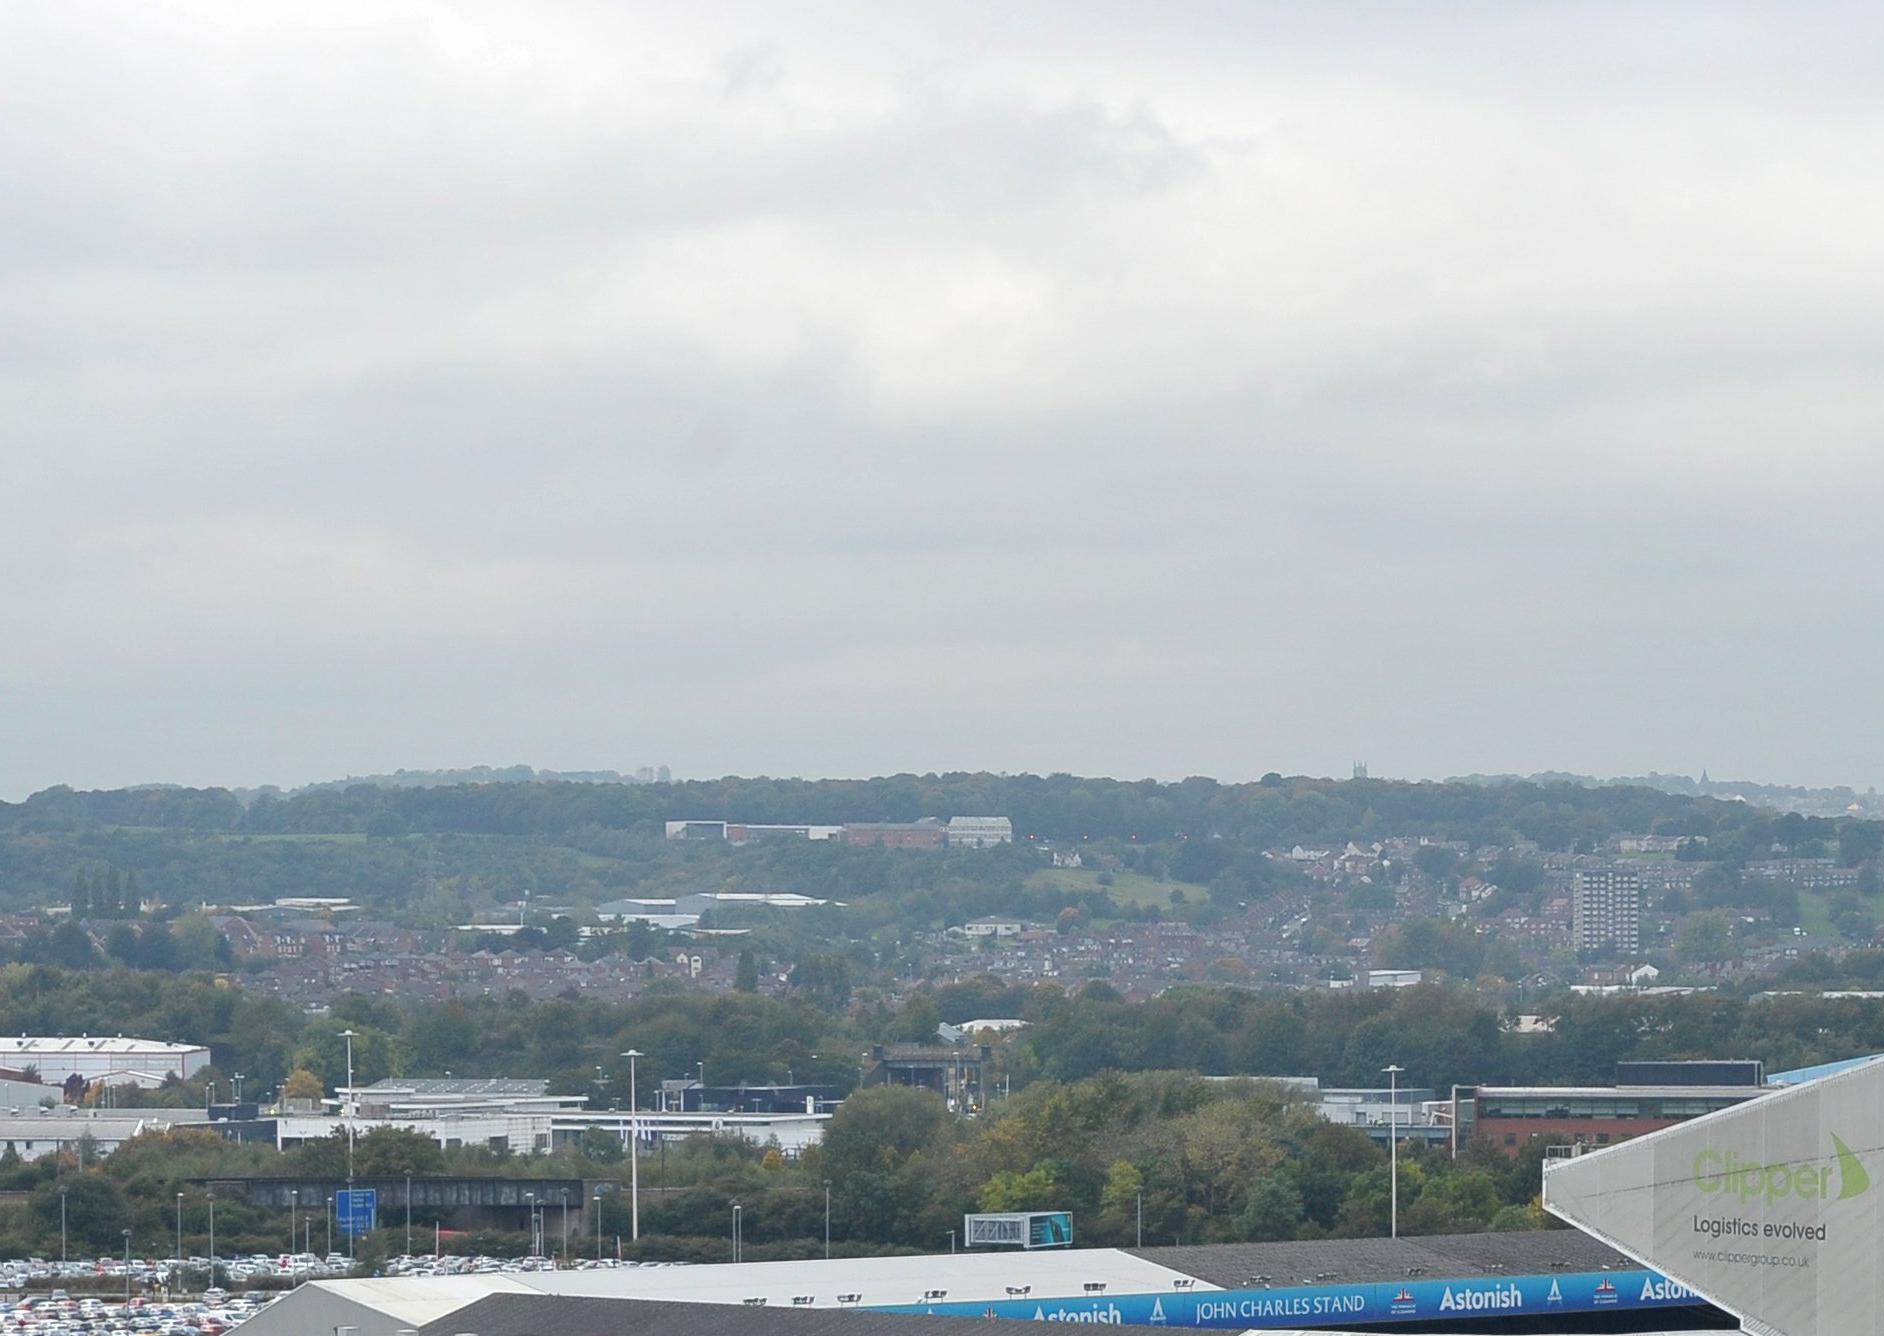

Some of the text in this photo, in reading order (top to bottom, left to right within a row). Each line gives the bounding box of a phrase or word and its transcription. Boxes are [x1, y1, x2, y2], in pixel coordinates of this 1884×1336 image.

[1693, 1149, 1833, 1209] Clipper
[1693, 1215, 1826, 1241] Logistics evolved
[1692, 1249, 1810, 1268] www.clippergroup.co.uk
[1439, 1283, 1522, 1311] Astonish
[1640, 1277, 1697, 1301] Aston
[1196, 1295, 1365, 1324] JOHN CHARLES STAND
